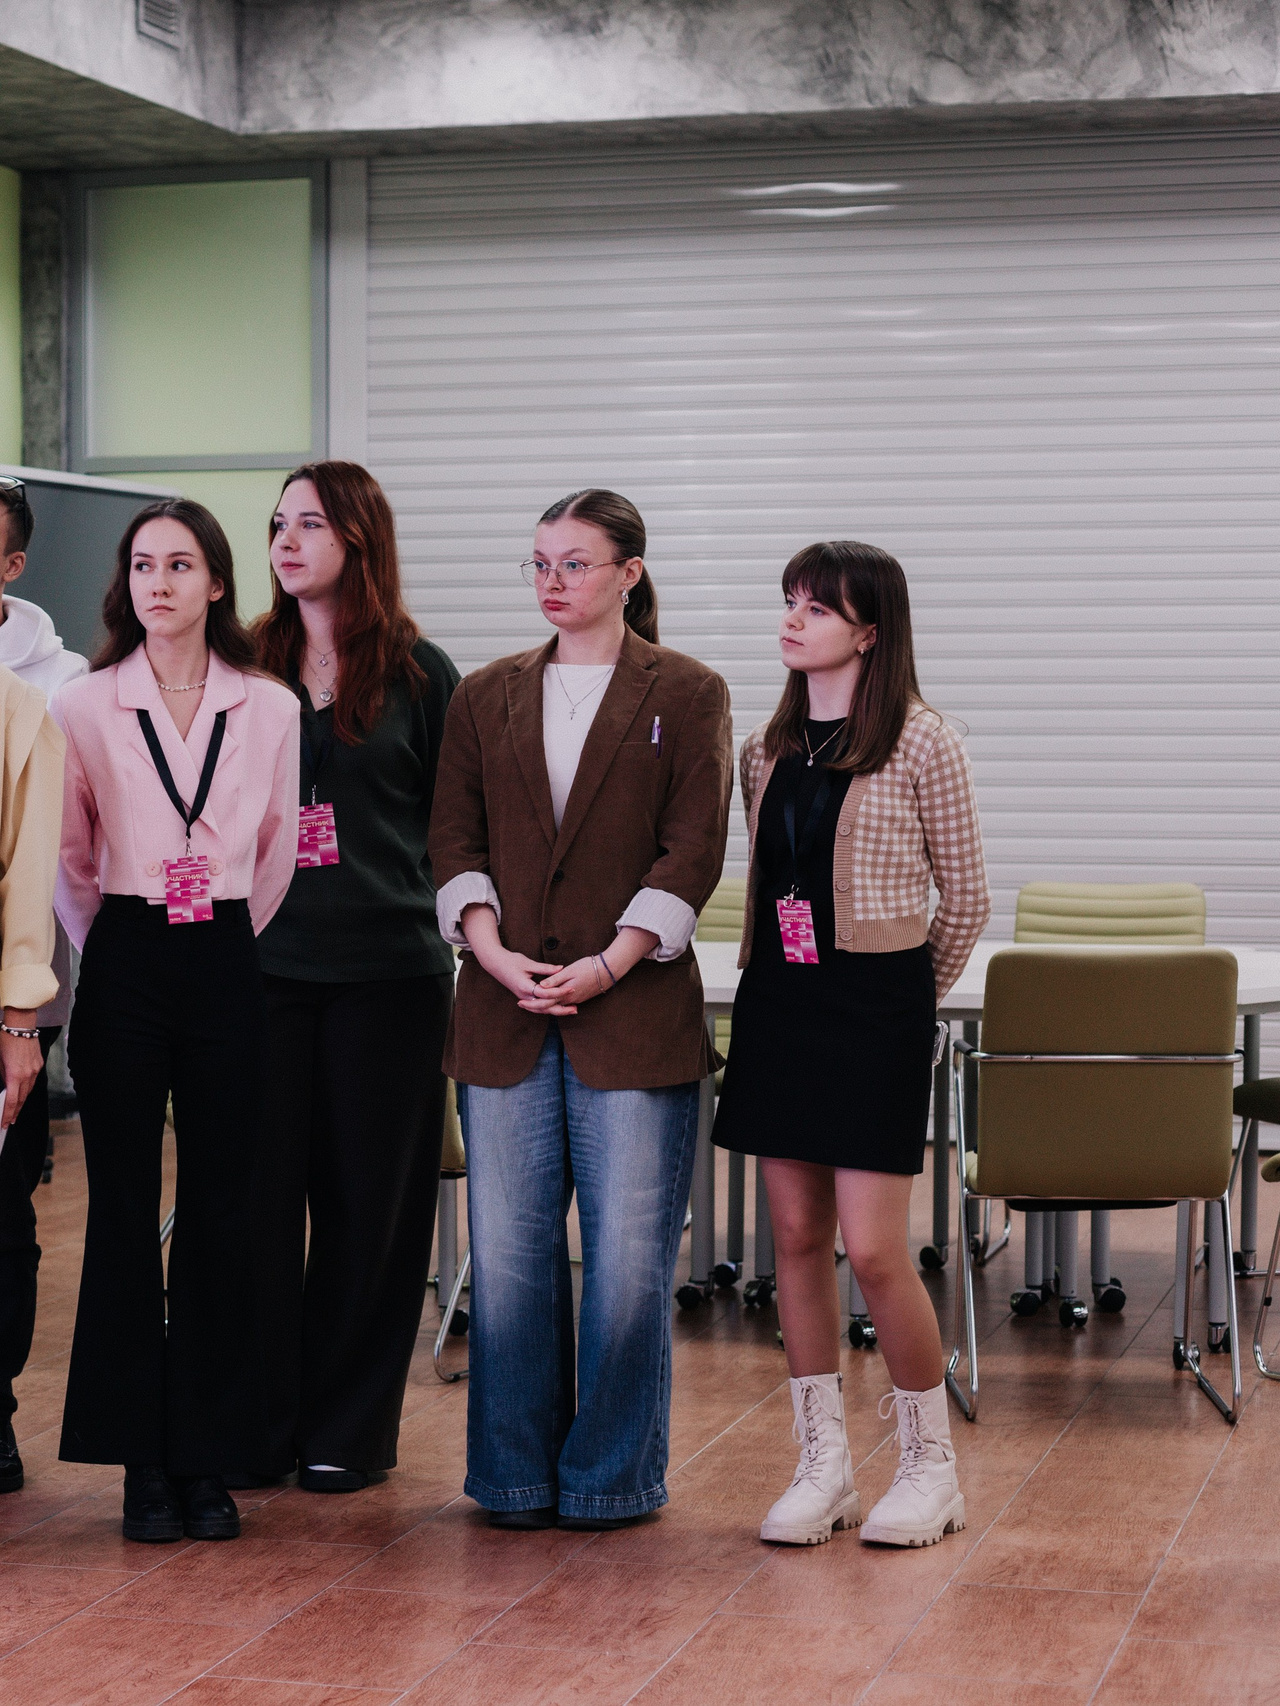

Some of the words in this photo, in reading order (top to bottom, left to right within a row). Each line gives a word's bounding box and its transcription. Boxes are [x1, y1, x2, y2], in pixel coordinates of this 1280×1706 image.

[298, 820, 328, 828] ЧАСТНИК
[166, 873, 203, 882] УЧАСТНИК
[780, 916, 808, 924] УЧАСТНИК
